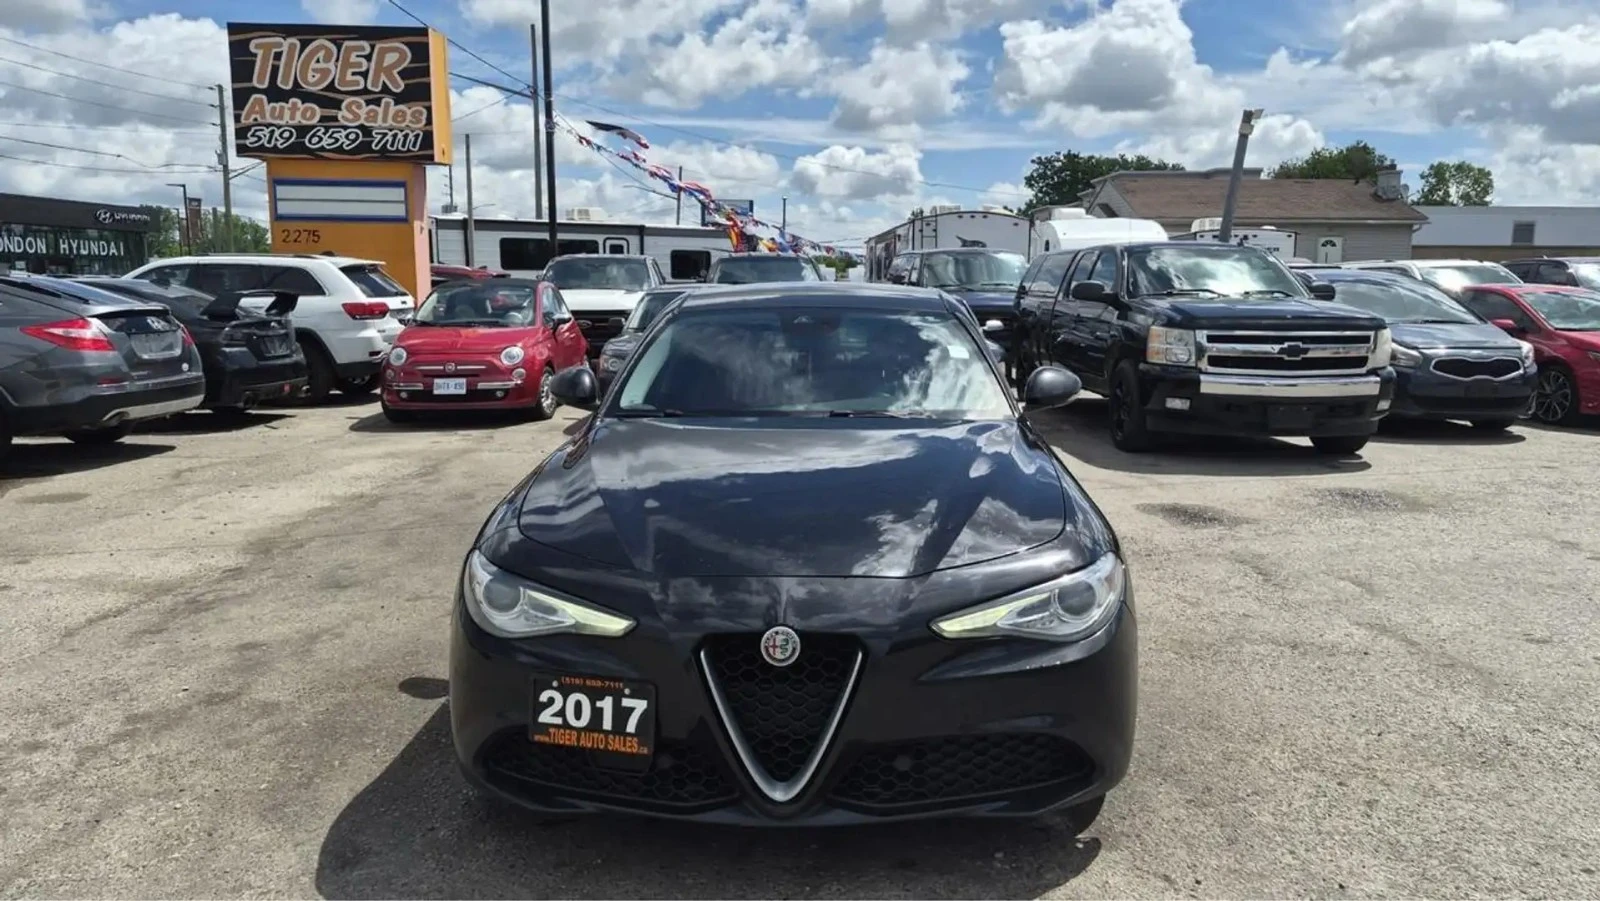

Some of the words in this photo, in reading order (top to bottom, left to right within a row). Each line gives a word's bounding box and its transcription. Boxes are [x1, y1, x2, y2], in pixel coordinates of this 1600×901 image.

[249, 37, 412, 93] TIGER
[241, 94, 321, 124] Auto
[338, 96, 428, 127] Sales
[246, 126, 297, 149] 519
[305, 126, 362, 149] 659
[371, 129, 424, 151] 7111
[0, 235, 46, 254] NDON
[60, 238, 124, 256] HYUNDAI
[281, 228, 321, 244] 2275
[538, 689, 648, 734] 2017
[579, 731, 606, 750] AUTO
